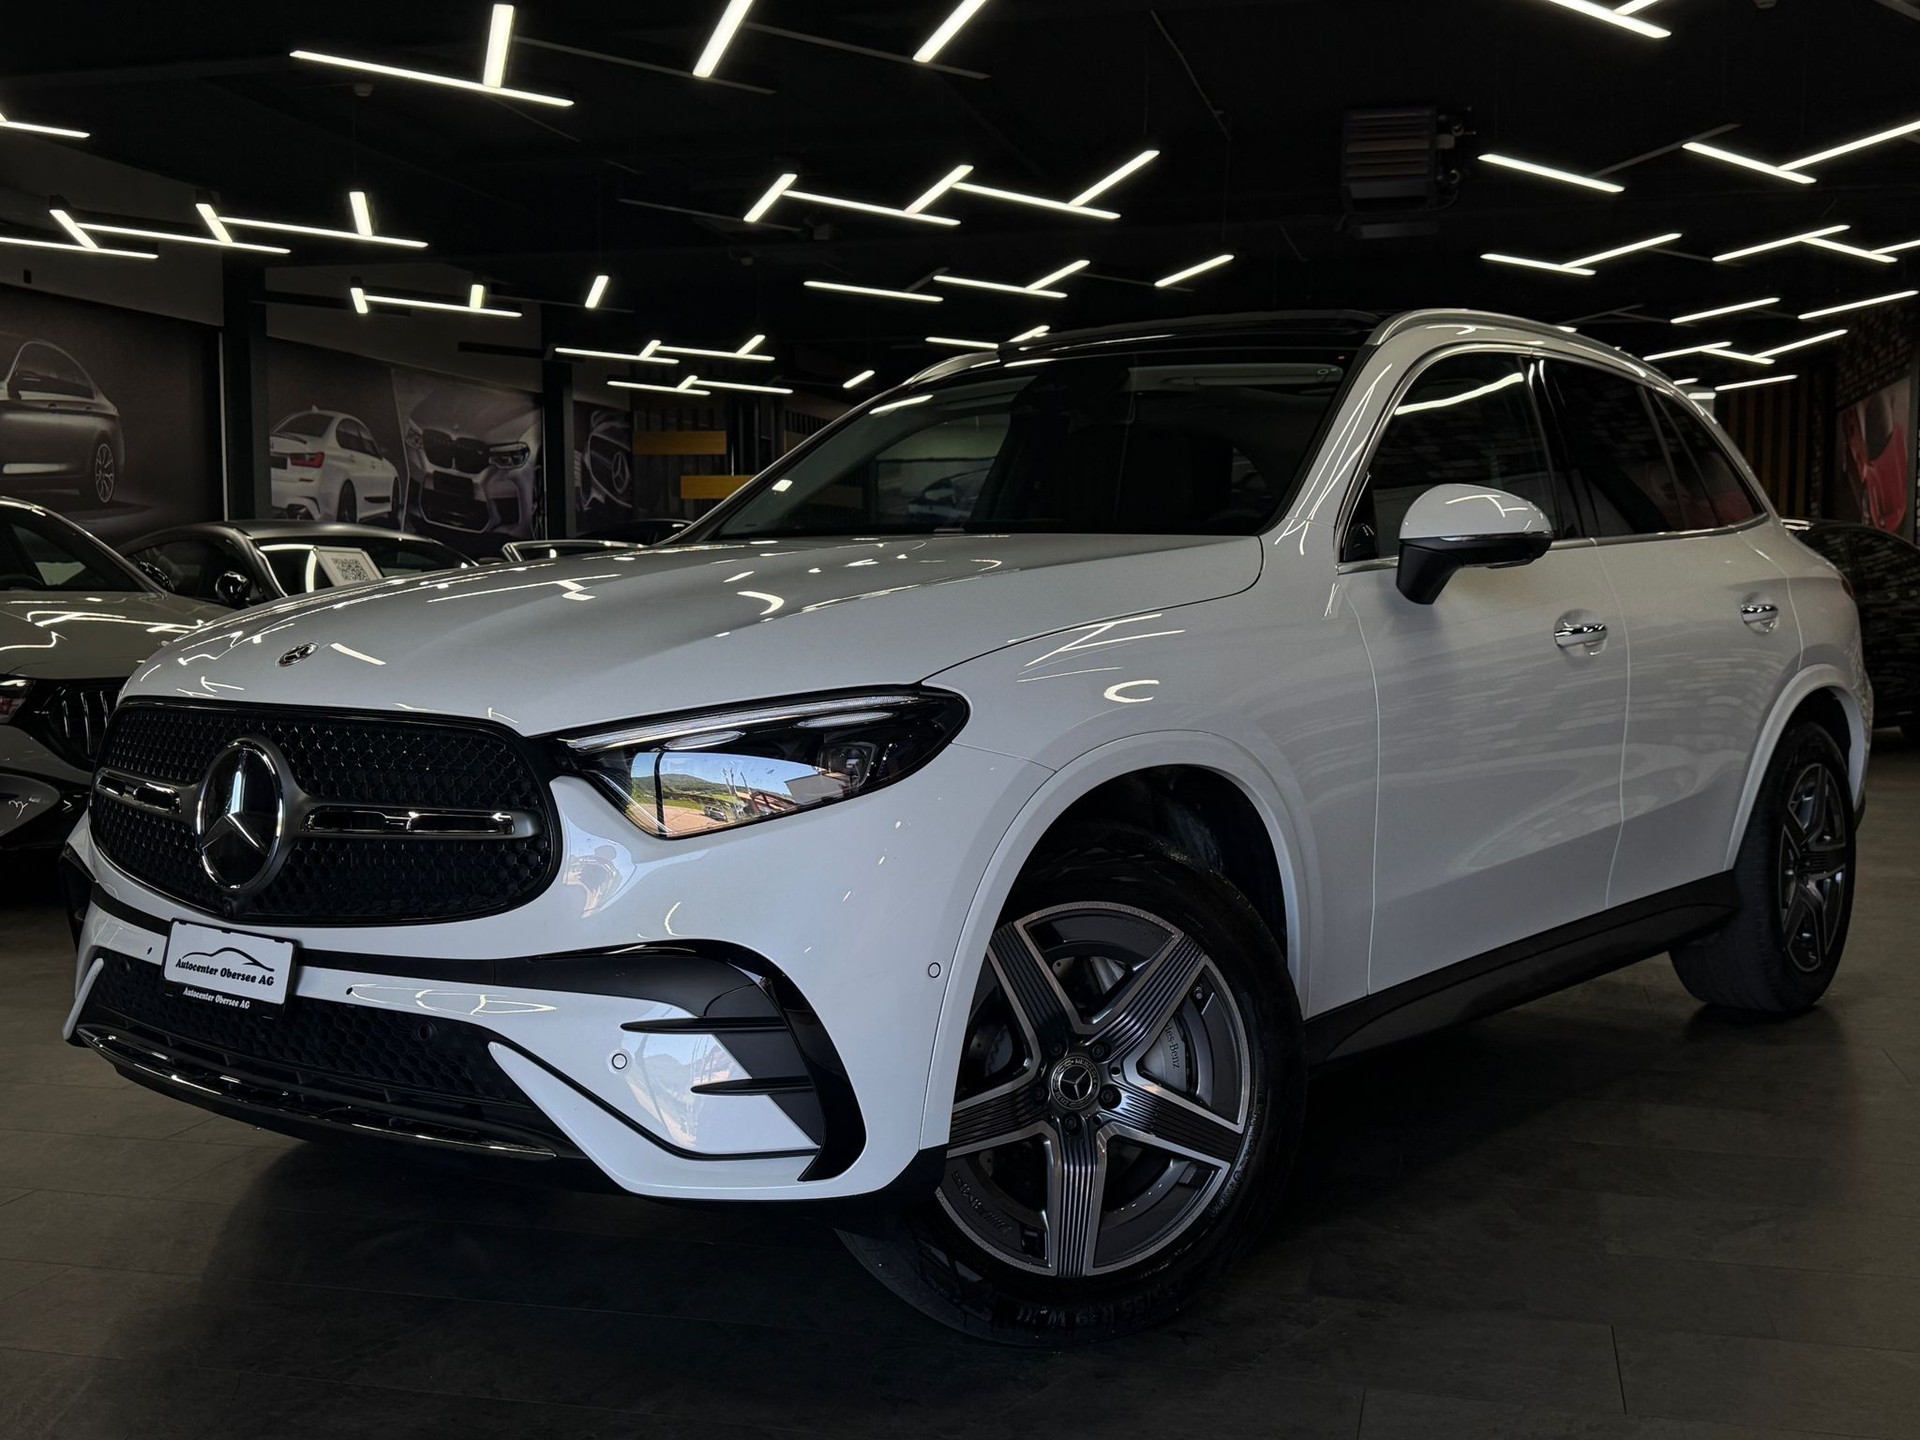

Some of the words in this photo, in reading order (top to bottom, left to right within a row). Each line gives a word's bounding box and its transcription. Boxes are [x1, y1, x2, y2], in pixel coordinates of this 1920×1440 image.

[175, 958, 219, 976] Autocenter
[220, 968, 256, 983] Obersee
[258, 975, 275, 986] AG
[183, 987, 215, 1002] Autocenter
[215, 994, 239, 1008] Obersee
[239, 1000, 251, 1010] AG
